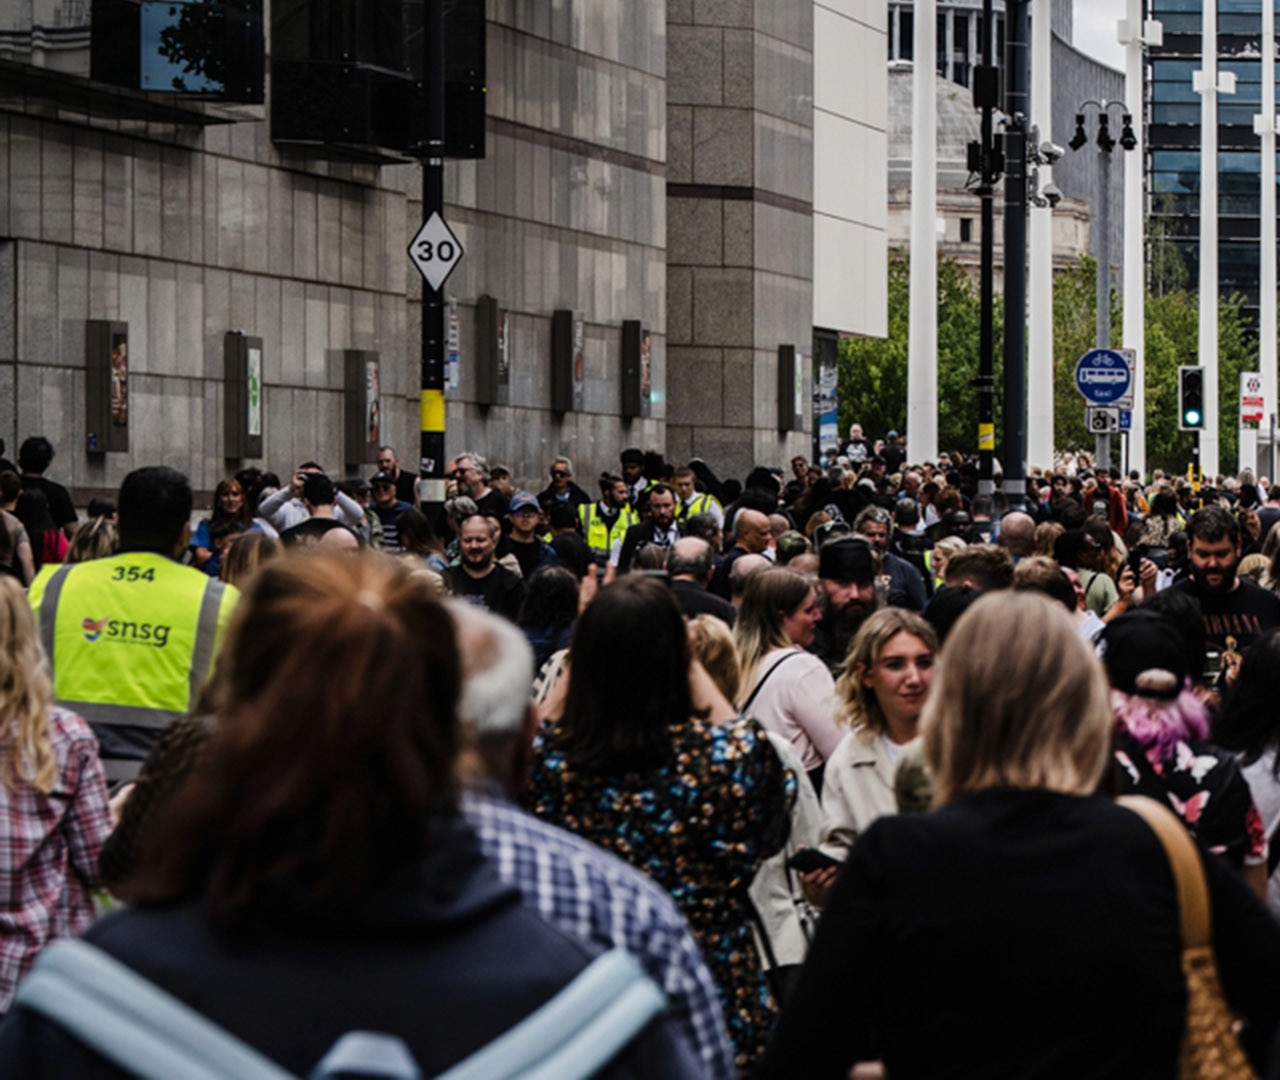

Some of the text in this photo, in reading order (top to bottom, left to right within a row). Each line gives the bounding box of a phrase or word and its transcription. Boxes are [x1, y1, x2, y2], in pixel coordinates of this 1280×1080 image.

[417, 240, 455, 262] 30
[112, 566, 155, 582] 354
[107, 619, 171, 648] snsg
